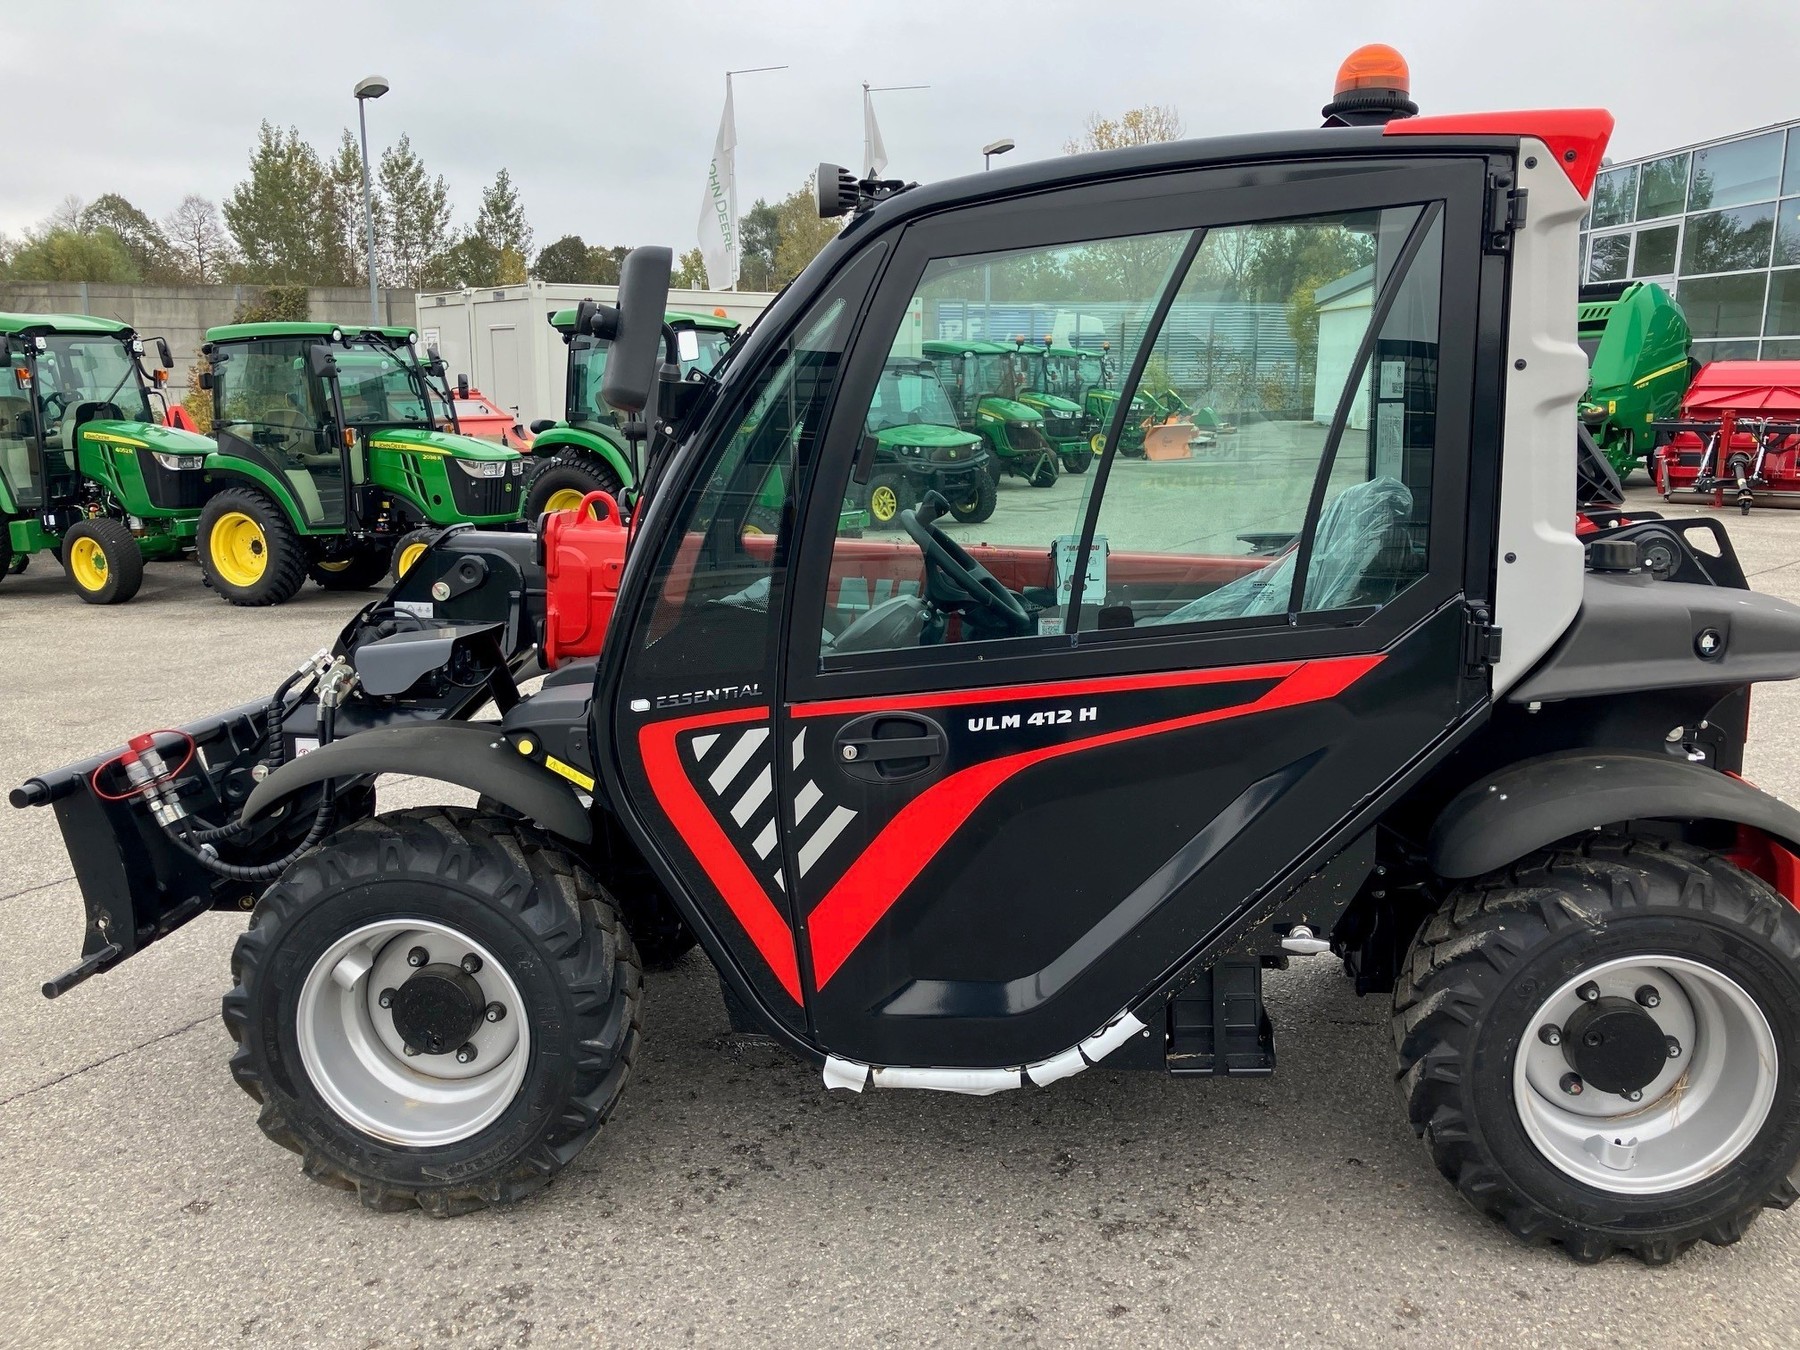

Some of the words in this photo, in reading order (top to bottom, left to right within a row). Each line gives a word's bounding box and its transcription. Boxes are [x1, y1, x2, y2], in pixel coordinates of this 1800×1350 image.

[709, 158, 722, 197] OHN
[715, 200, 734, 253] DEERE
[656, 683, 763, 709] ESSENTIAL
[968, 714, 1021, 732] ULM
[1027, 709, 1073, 726] 412
[1079, 706, 1098, 722] H
